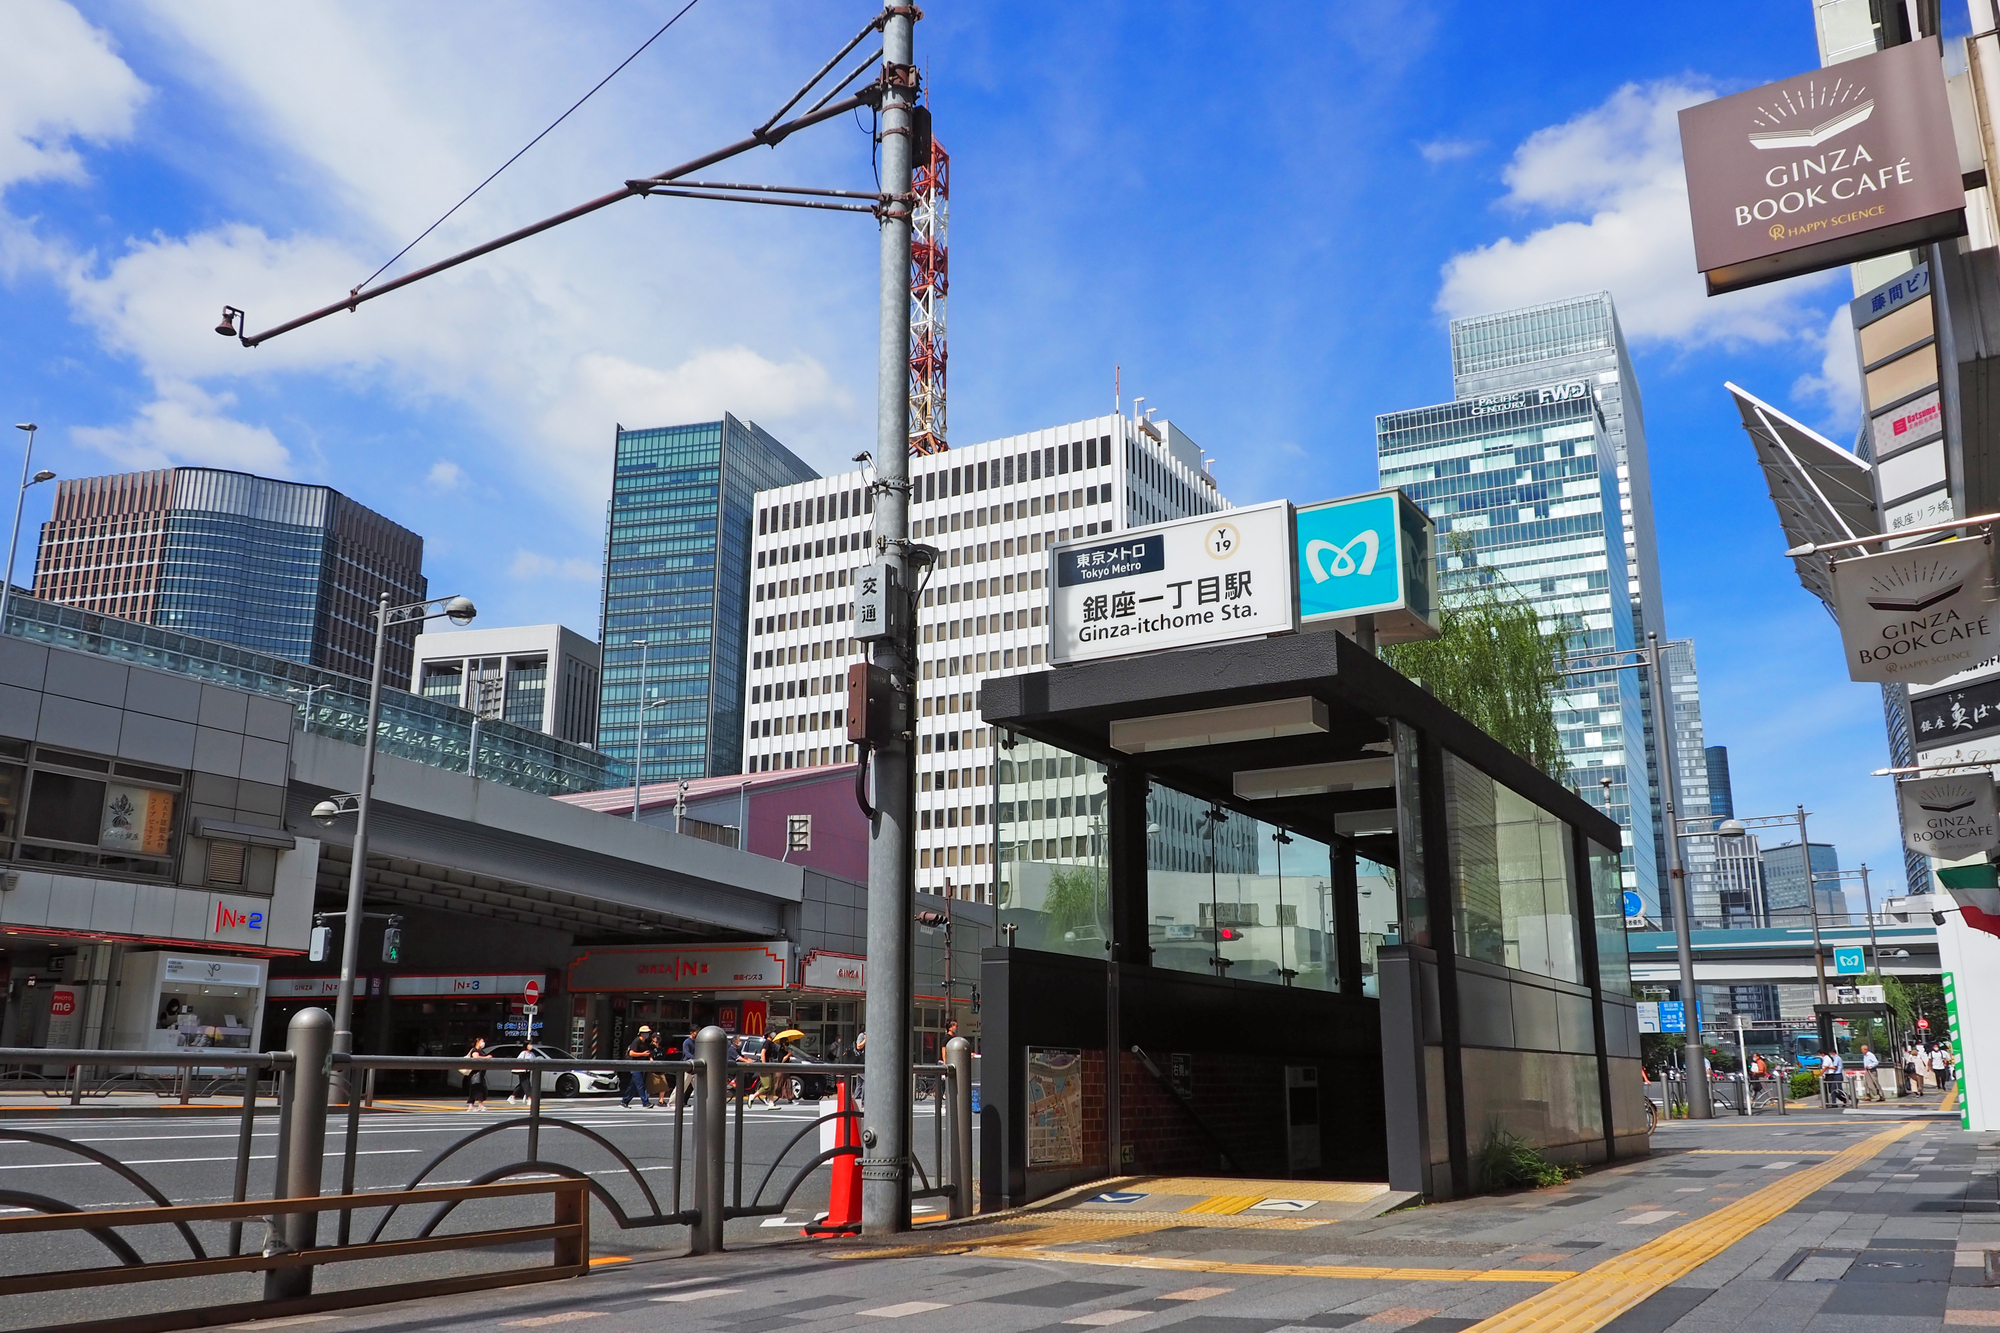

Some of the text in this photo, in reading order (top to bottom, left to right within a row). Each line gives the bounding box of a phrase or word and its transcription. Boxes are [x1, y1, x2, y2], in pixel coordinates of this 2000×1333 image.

[1765, 144, 1873, 188] GINZA
[1734, 157, 1913, 227] BOOK CAFÉ
[1788, 204, 1886, 238] HAPPY SCIENCE
[1539, 382, 1586, 404] FWD
[1892, 499, 1953, 530] 銀座リラ矯
[1215, 539, 1231, 552] 19
[1217, 529, 1227, 539] Y
[1076, 543, 1145, 568] 東京メトロ
[1080, 560, 1141, 580] Tokyo Metro
[861, 577, 877, 623] 交通
[1083, 570, 1252, 623] 銀座一丁目駅
[1079, 604, 1258, 642] Ginza-itchome Sta.
[1882, 609, 1961, 639] GINZA
[1859, 615, 1991, 664] BOOK CAFÉ
[1900, 658, 1929, 672] HAPPY
[1931, 651, 1972, 665] SCIENCE
[1913, 823, 1994, 842] BOOK CAFÉ
[1927, 815, 1976, 829] GINZA
[638, 965, 672, 974] GINZA
[838, 968, 859, 979] GINZA
[52, 1002, 71, 1012] me
